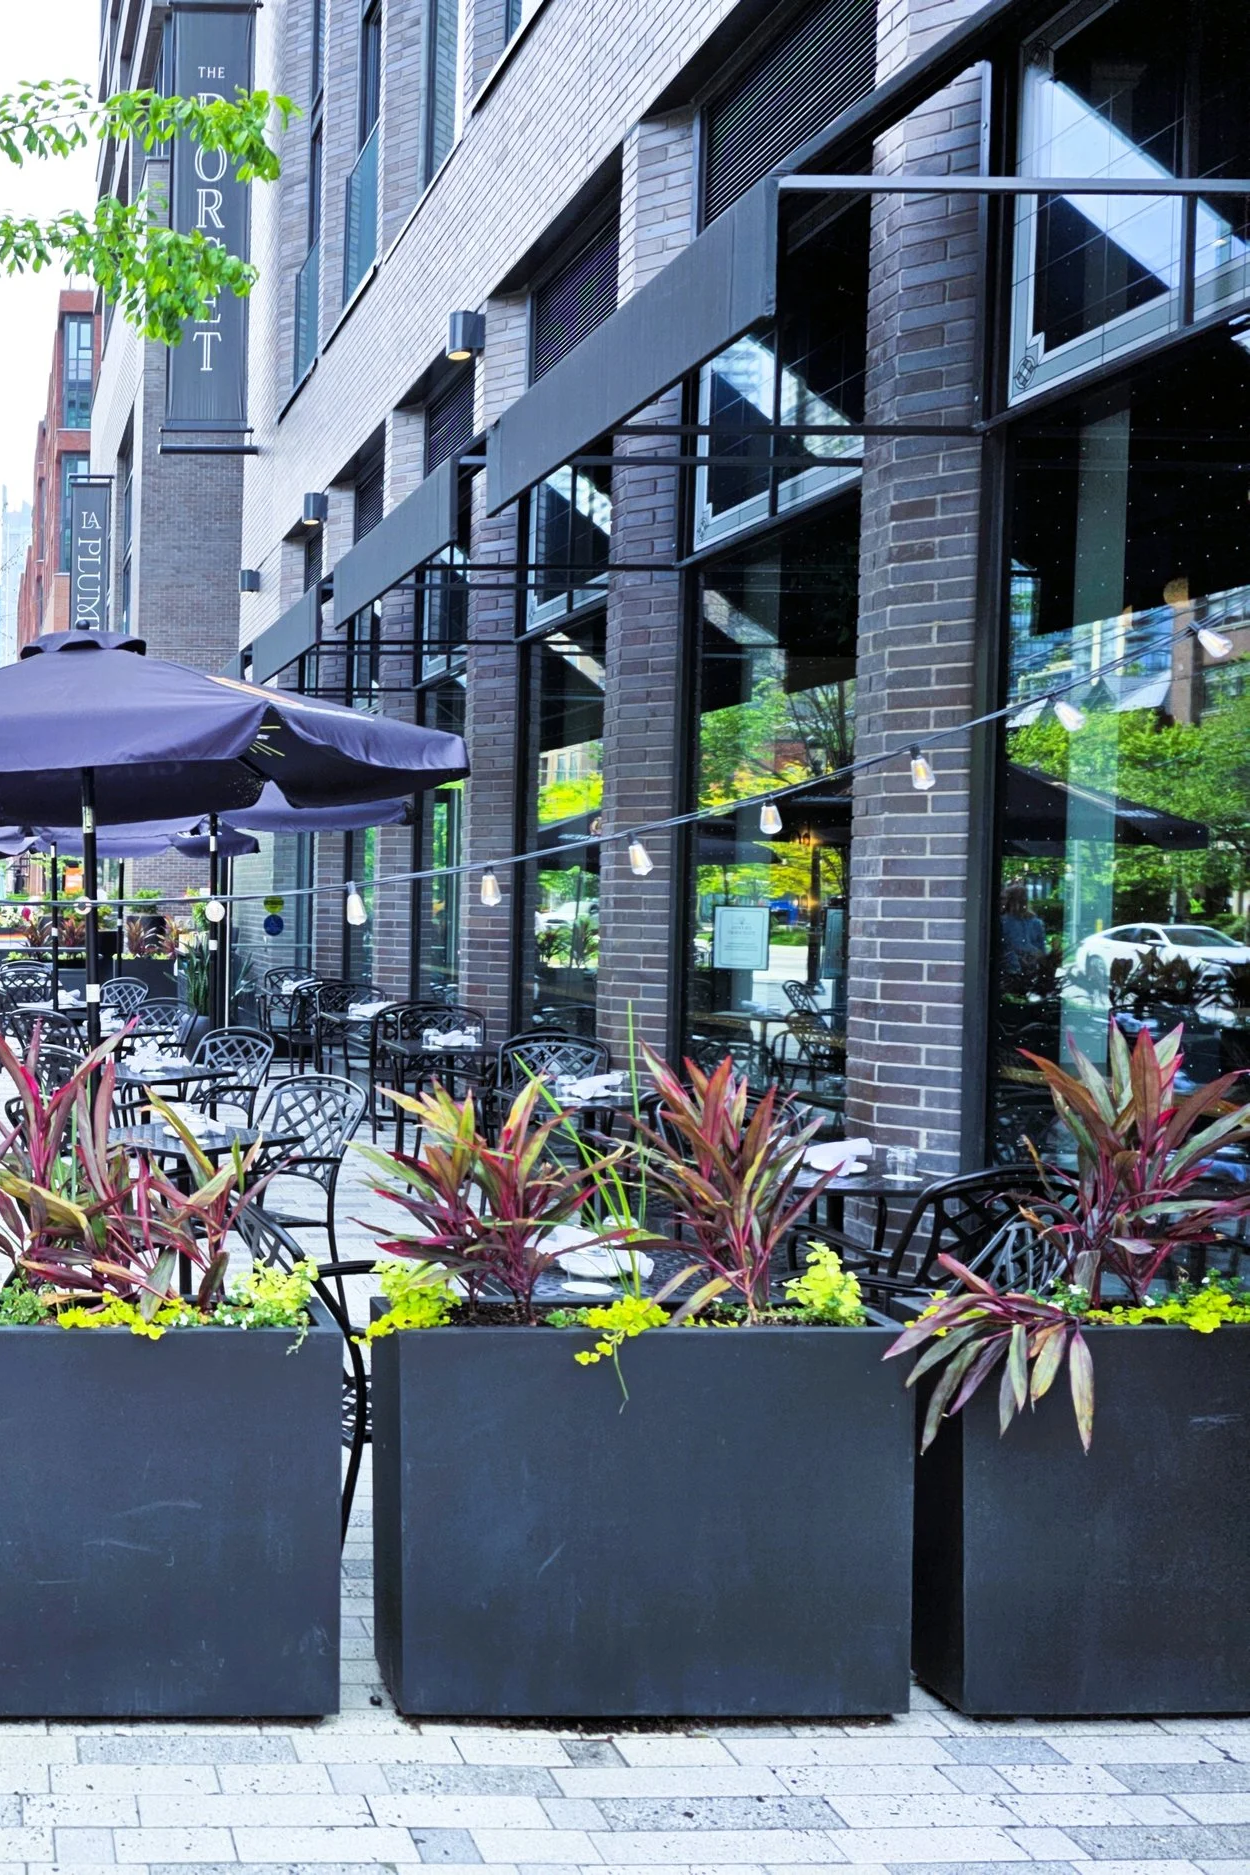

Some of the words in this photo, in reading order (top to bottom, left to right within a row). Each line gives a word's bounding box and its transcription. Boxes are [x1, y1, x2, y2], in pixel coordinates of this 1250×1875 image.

[197, 66, 226, 79] THE
[193, 92, 228, 372] ORET
[81, 511, 102, 529] LA
[76, 537, 102, 632] PLUM
